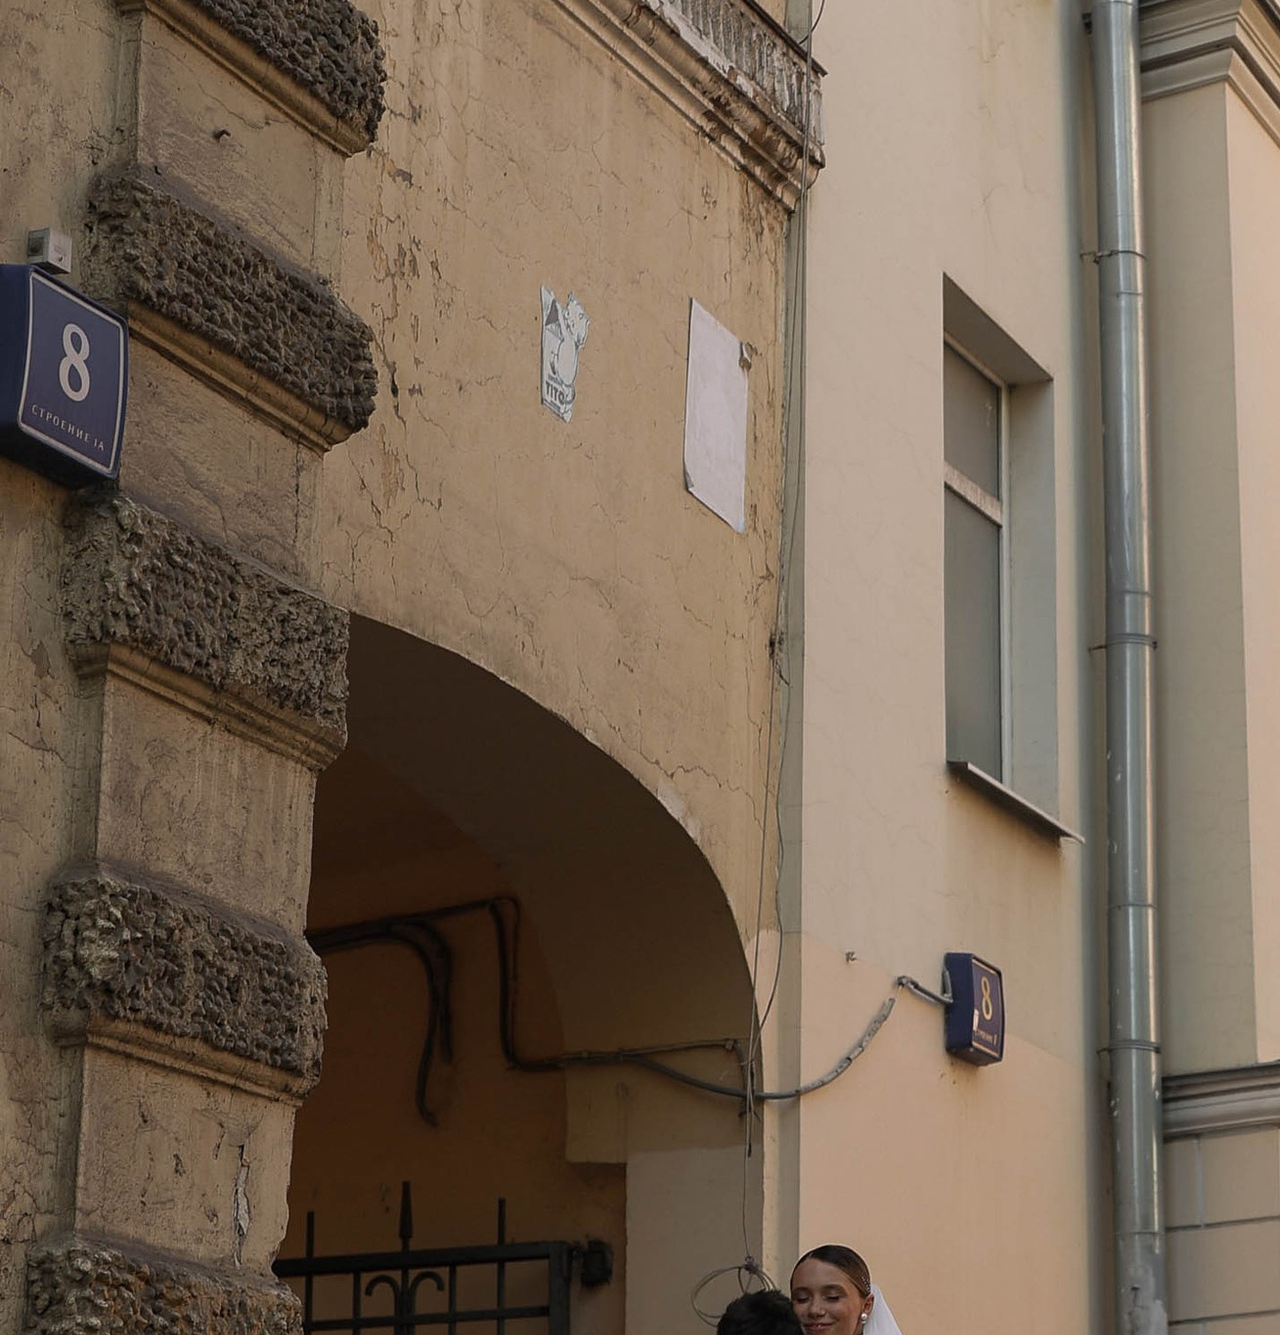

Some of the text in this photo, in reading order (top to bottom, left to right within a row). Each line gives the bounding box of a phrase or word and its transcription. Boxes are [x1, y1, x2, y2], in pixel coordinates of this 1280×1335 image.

[59, 323, 90, 402] 8
[31, 404, 90, 443] СТРОЕНИЕ
[981, 976, 992, 1021] 8
